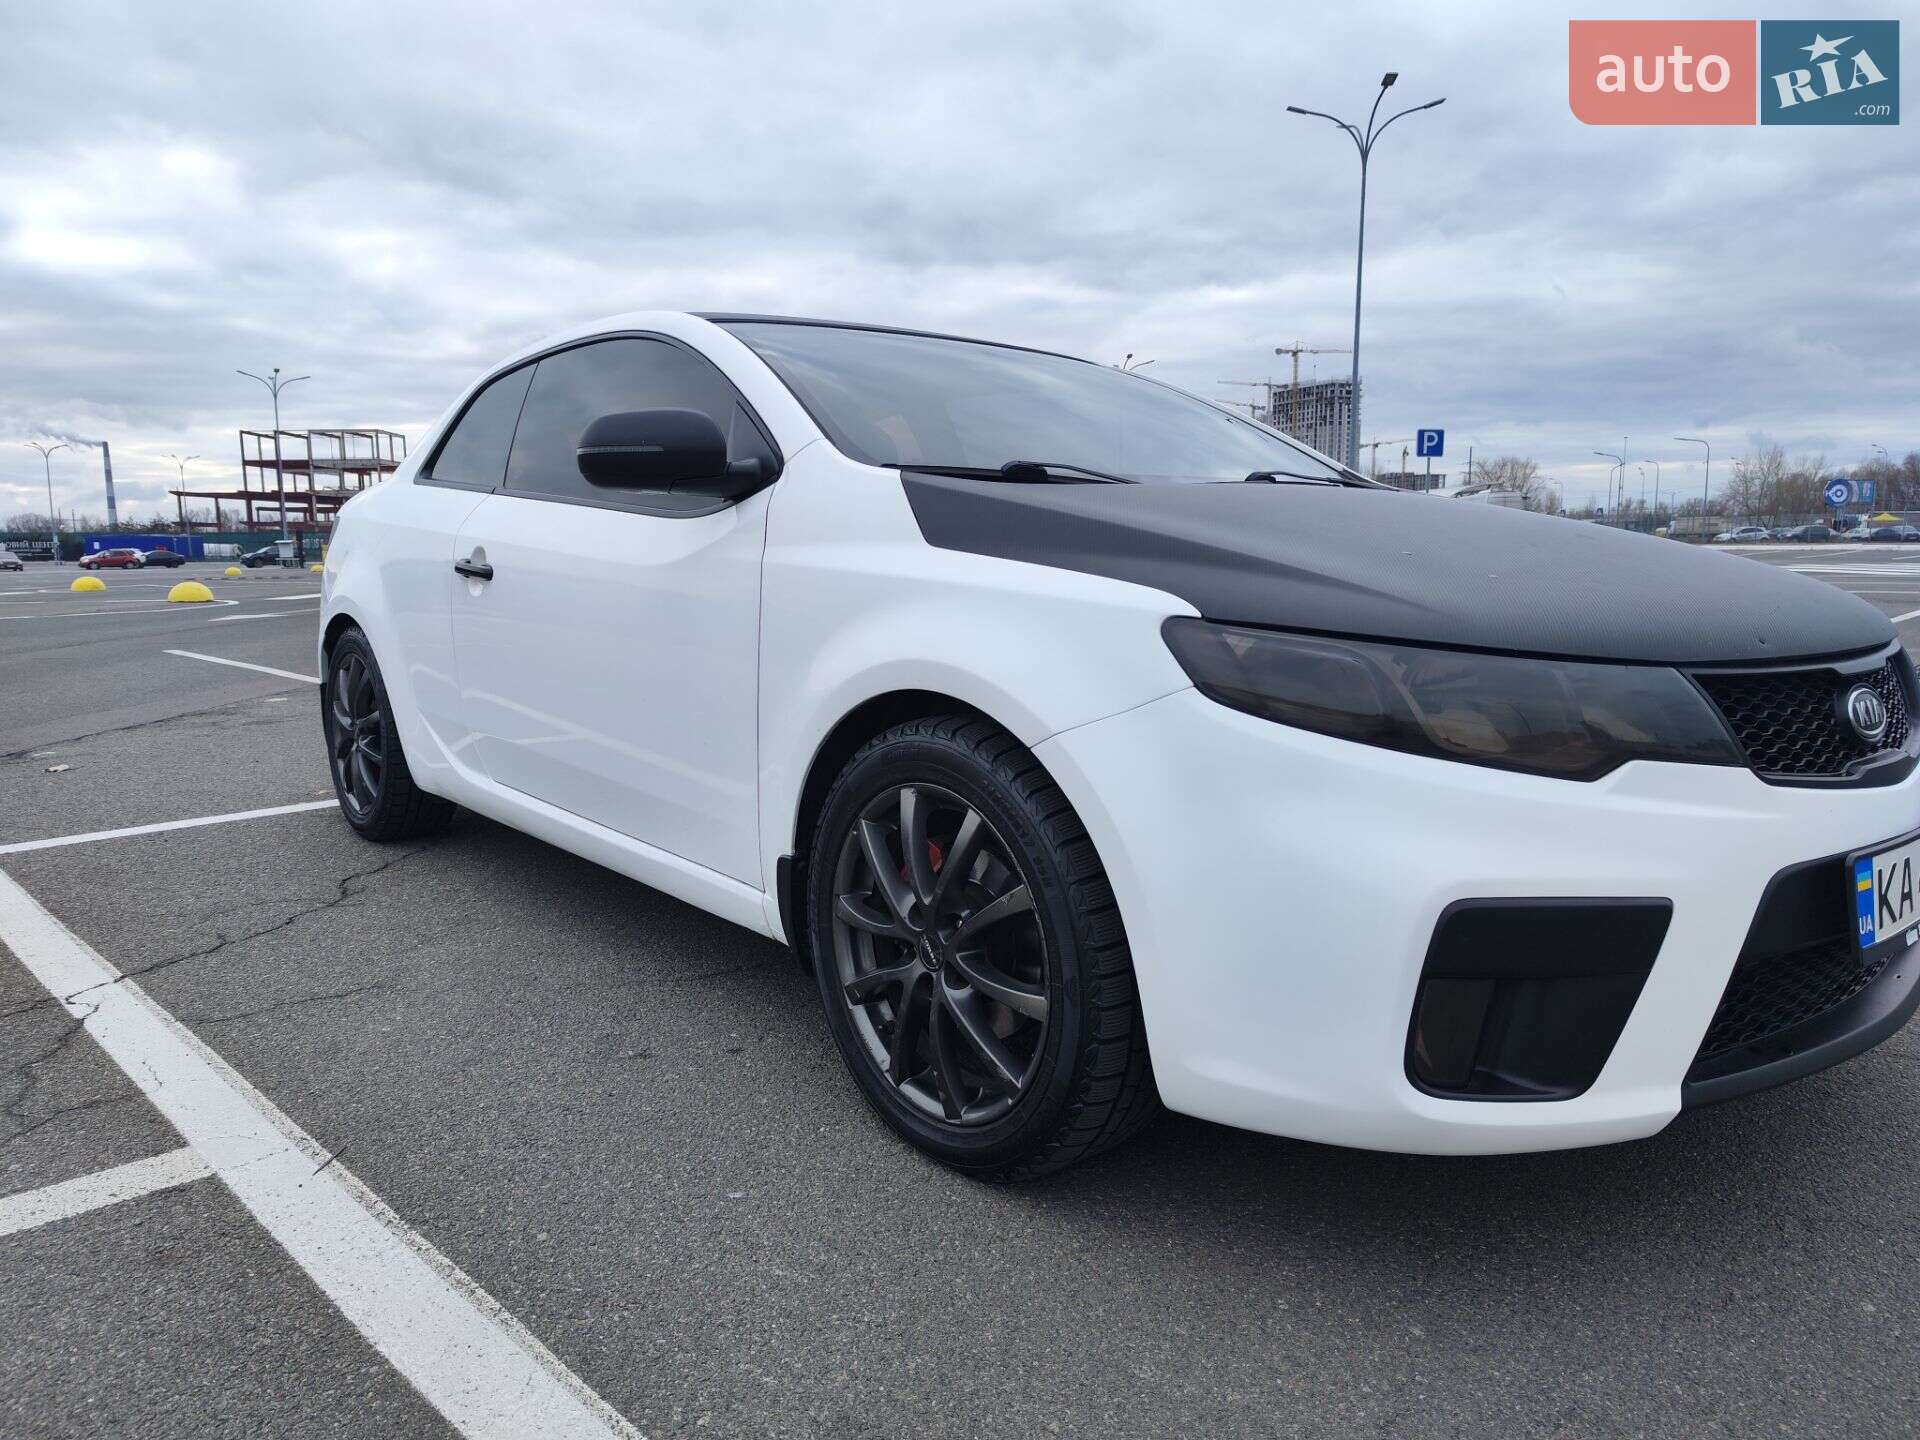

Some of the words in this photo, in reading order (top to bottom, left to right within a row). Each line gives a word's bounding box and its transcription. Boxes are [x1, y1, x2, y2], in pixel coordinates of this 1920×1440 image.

[1423, 431, 1439, 454] P
[1878, 857, 1914, 930] KA
[1859, 914, 1874, 935] UA
